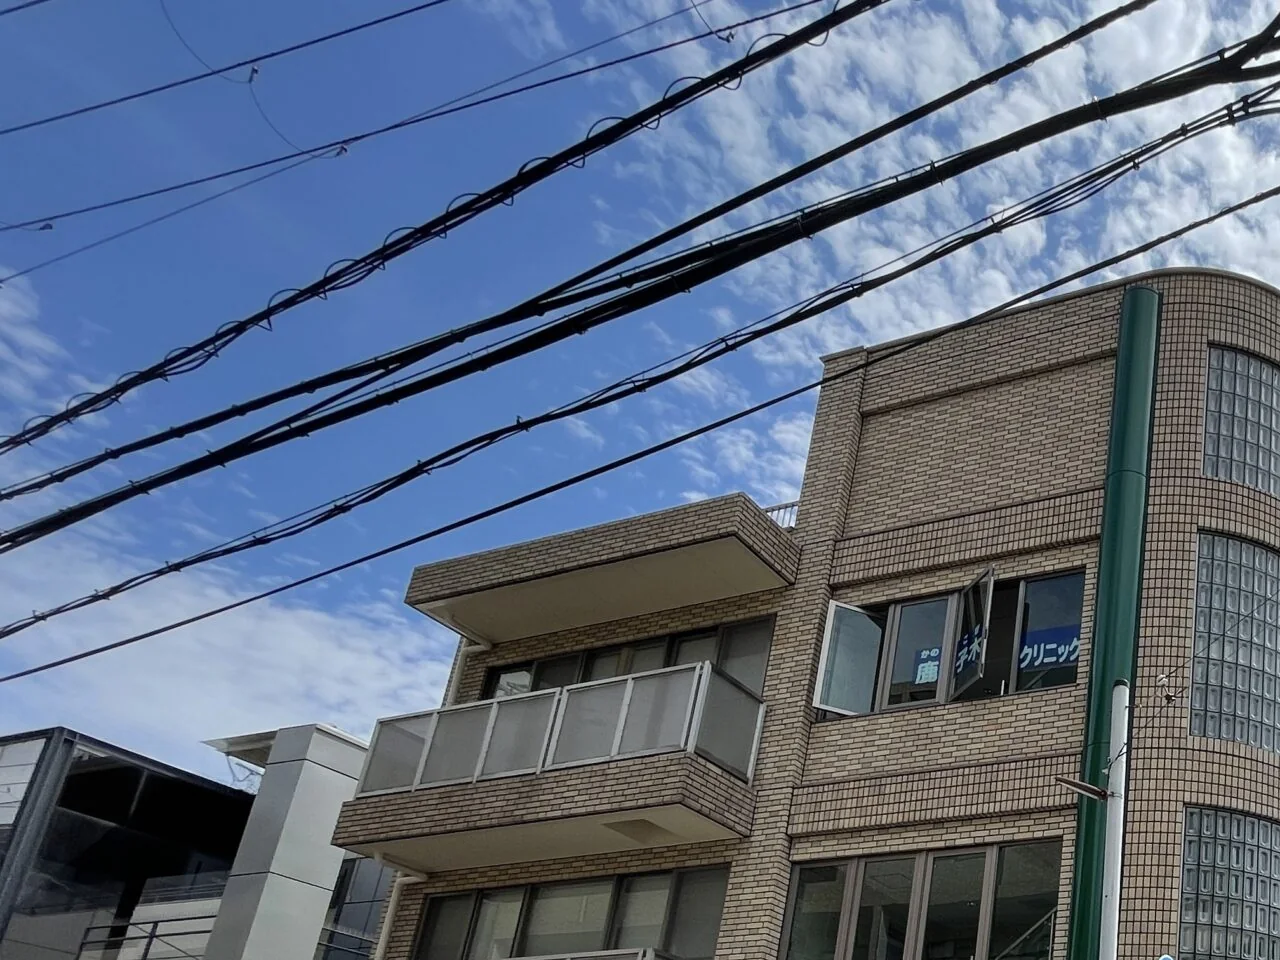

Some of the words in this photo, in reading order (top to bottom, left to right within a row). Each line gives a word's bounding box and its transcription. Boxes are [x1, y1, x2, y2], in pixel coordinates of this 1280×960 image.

[1020, 637, 1081, 668] クリニック
